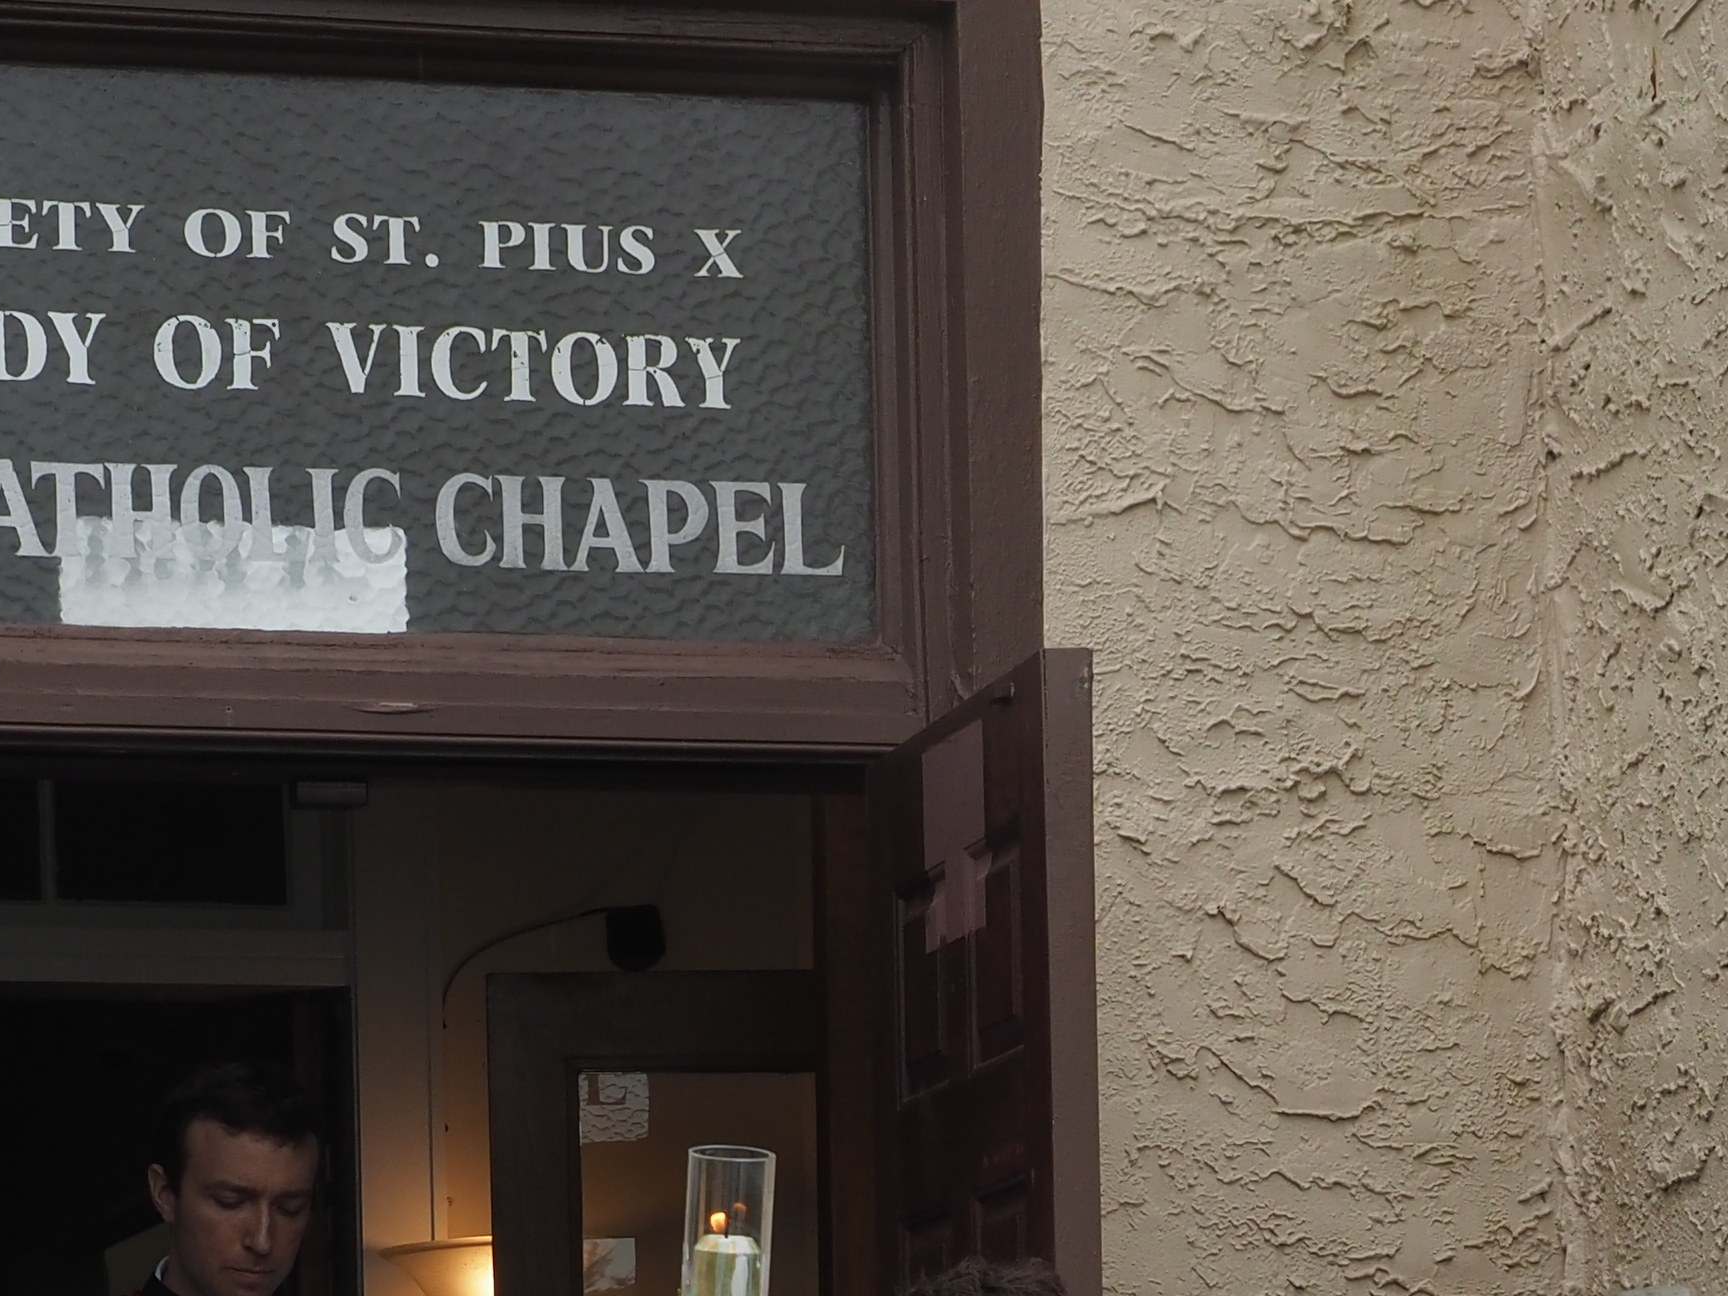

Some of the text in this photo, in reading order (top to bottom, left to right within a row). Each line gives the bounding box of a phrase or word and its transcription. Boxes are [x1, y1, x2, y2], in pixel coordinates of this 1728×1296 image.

[184, 208, 291, 259] OF
[331, 213, 441, 269] ST.
[478, 220, 656, 276] PIUS
[693, 229, 745, 280] X
[153, 314, 282, 391] OF
[325, 321, 742, 411] VICTORY
[434, 472, 847, 577] CHAPEL
